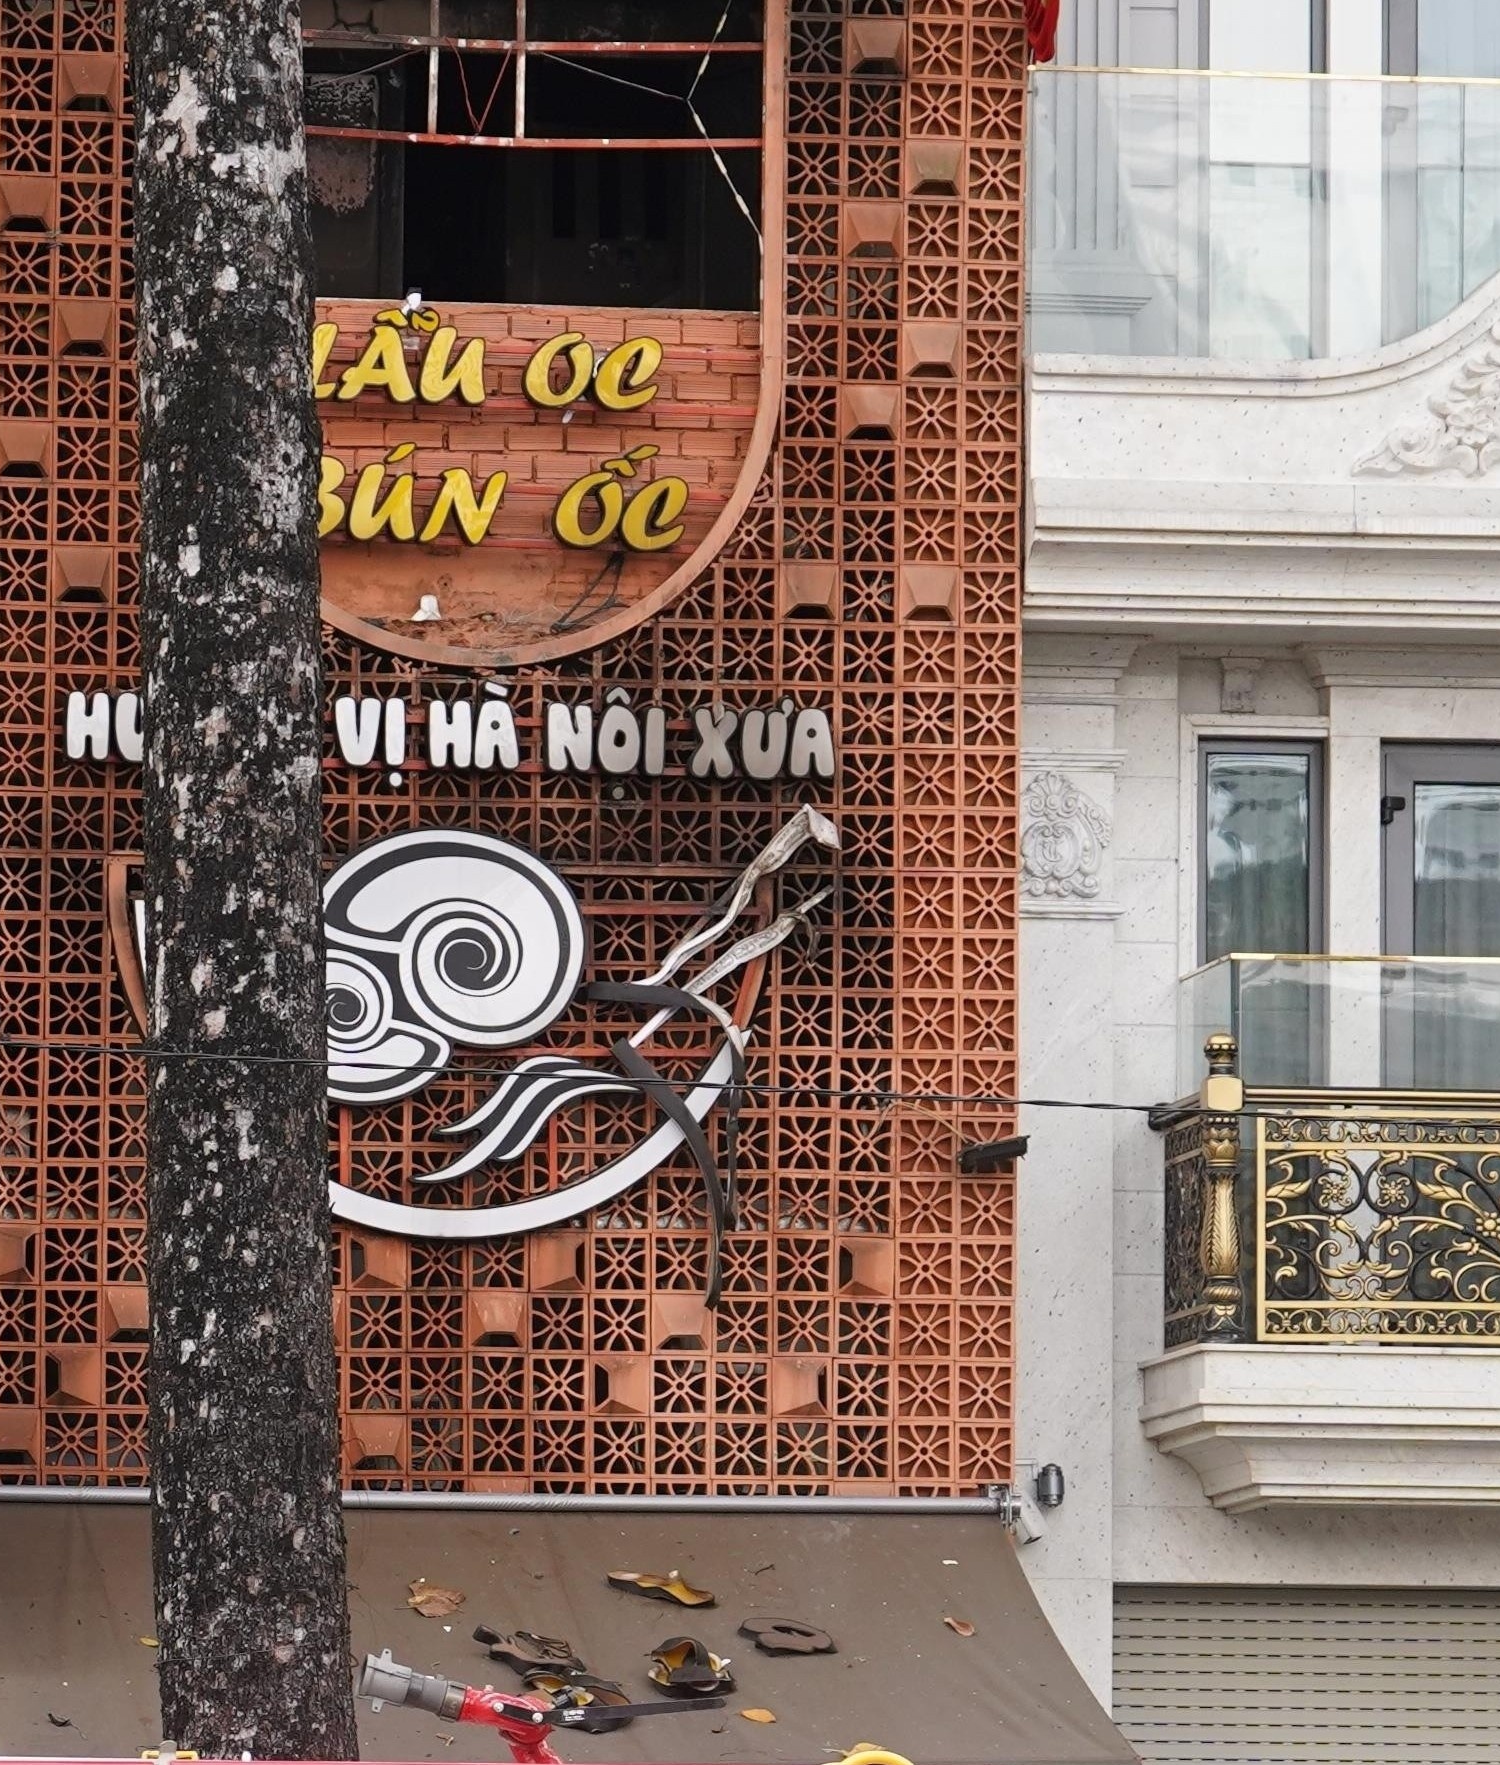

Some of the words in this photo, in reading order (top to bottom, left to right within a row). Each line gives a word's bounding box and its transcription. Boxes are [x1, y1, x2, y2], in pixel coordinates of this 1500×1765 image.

[553, 444, 691, 552] ỐC
[334, 695, 407, 787] VỊ
[428, 681, 520, 770] HÀ
[689, 695, 836, 779] XƯA
